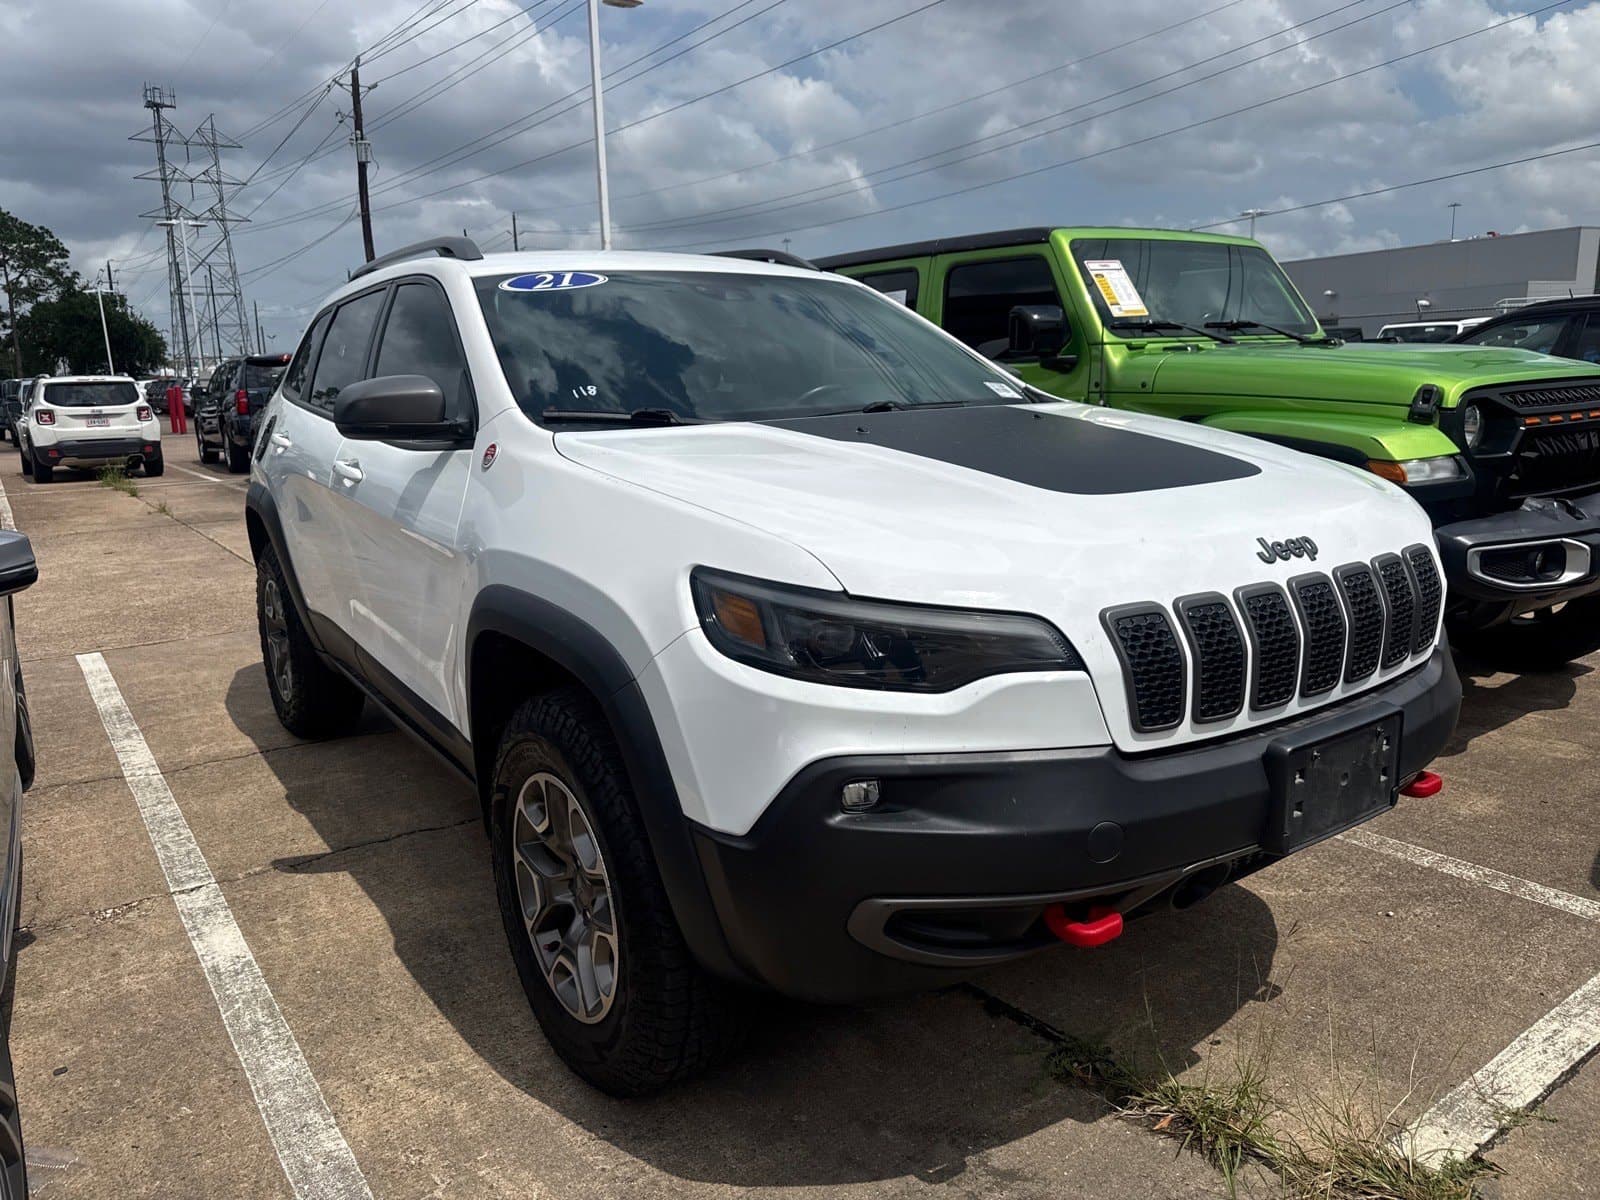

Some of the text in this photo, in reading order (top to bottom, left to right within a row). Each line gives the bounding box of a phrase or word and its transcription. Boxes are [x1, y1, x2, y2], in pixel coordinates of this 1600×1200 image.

[532, 272, 573, 289] 21
[572, 385, 598, 399] 118
[1256, 536, 1319, 564] Jeep
